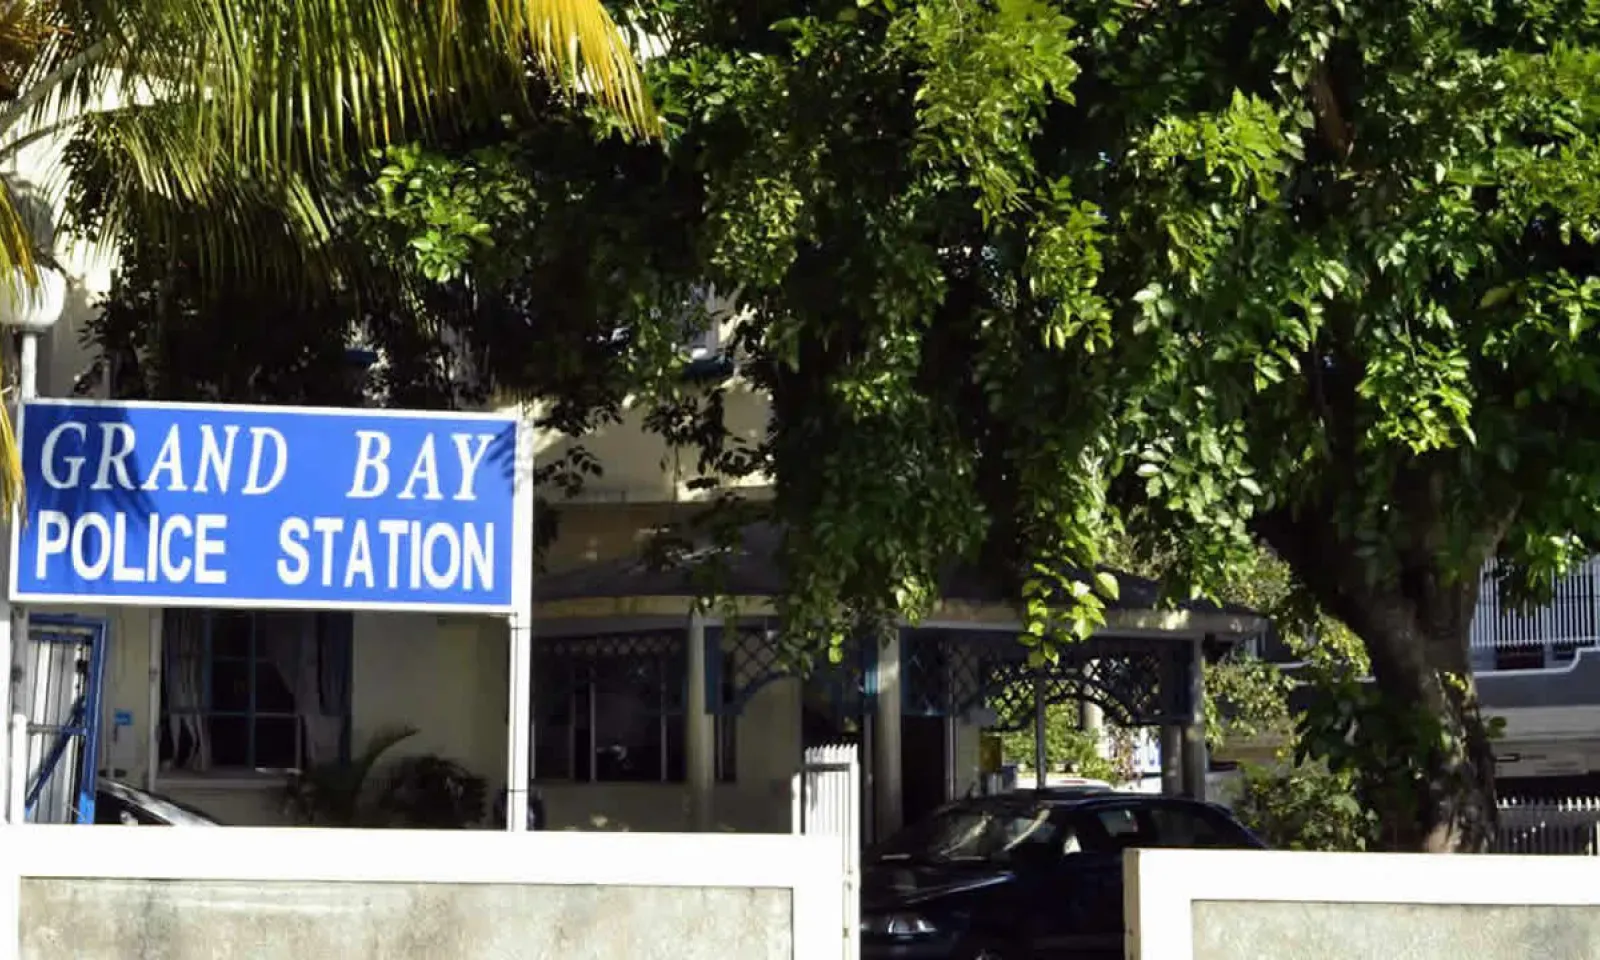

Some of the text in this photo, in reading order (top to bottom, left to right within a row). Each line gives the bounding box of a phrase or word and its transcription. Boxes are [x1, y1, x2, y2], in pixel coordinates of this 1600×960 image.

[40, 421, 495, 501] GRAND BAY
[35, 510, 495, 591] POLICE STATION
